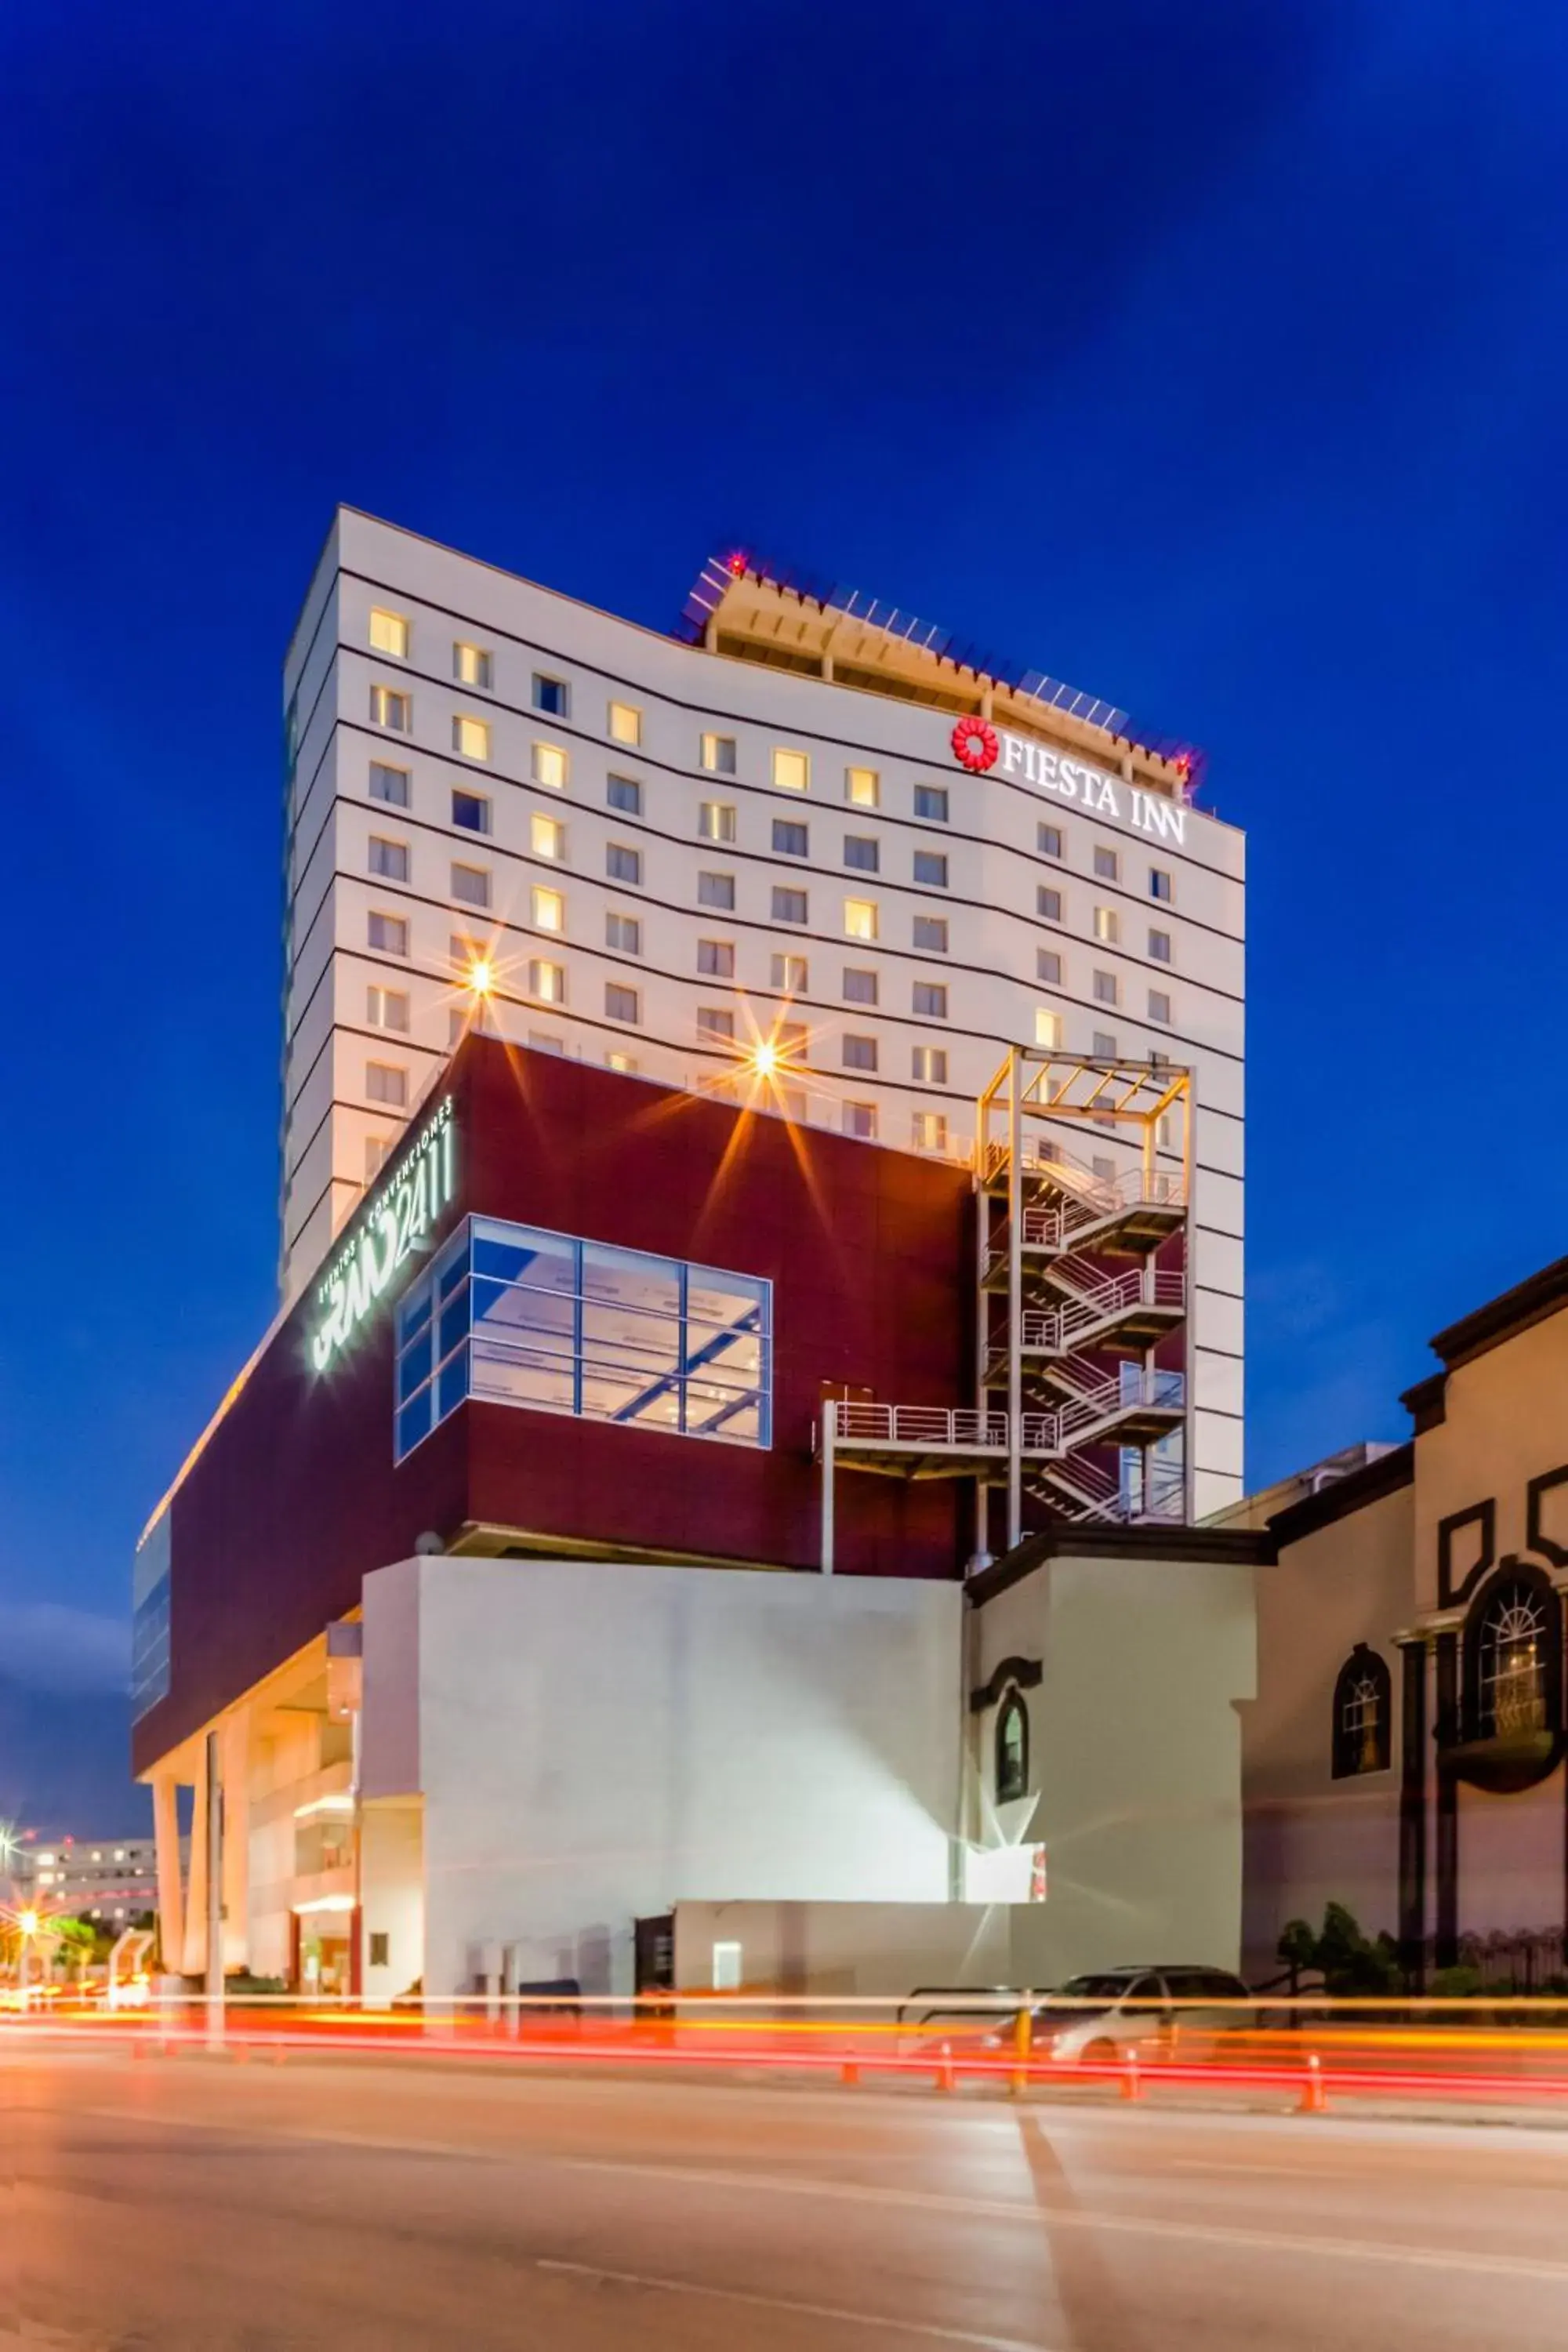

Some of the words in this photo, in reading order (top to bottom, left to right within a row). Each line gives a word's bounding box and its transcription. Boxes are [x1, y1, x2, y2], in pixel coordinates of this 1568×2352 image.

[1002, 734, 1120, 817] FIESTA
[1131, 789, 1188, 846] INN
[318, 1240, 355, 1304] EVENTOS
[368, 1094, 452, 1229] CONVENCIONES
[395, 1120, 452, 1269] 2411
